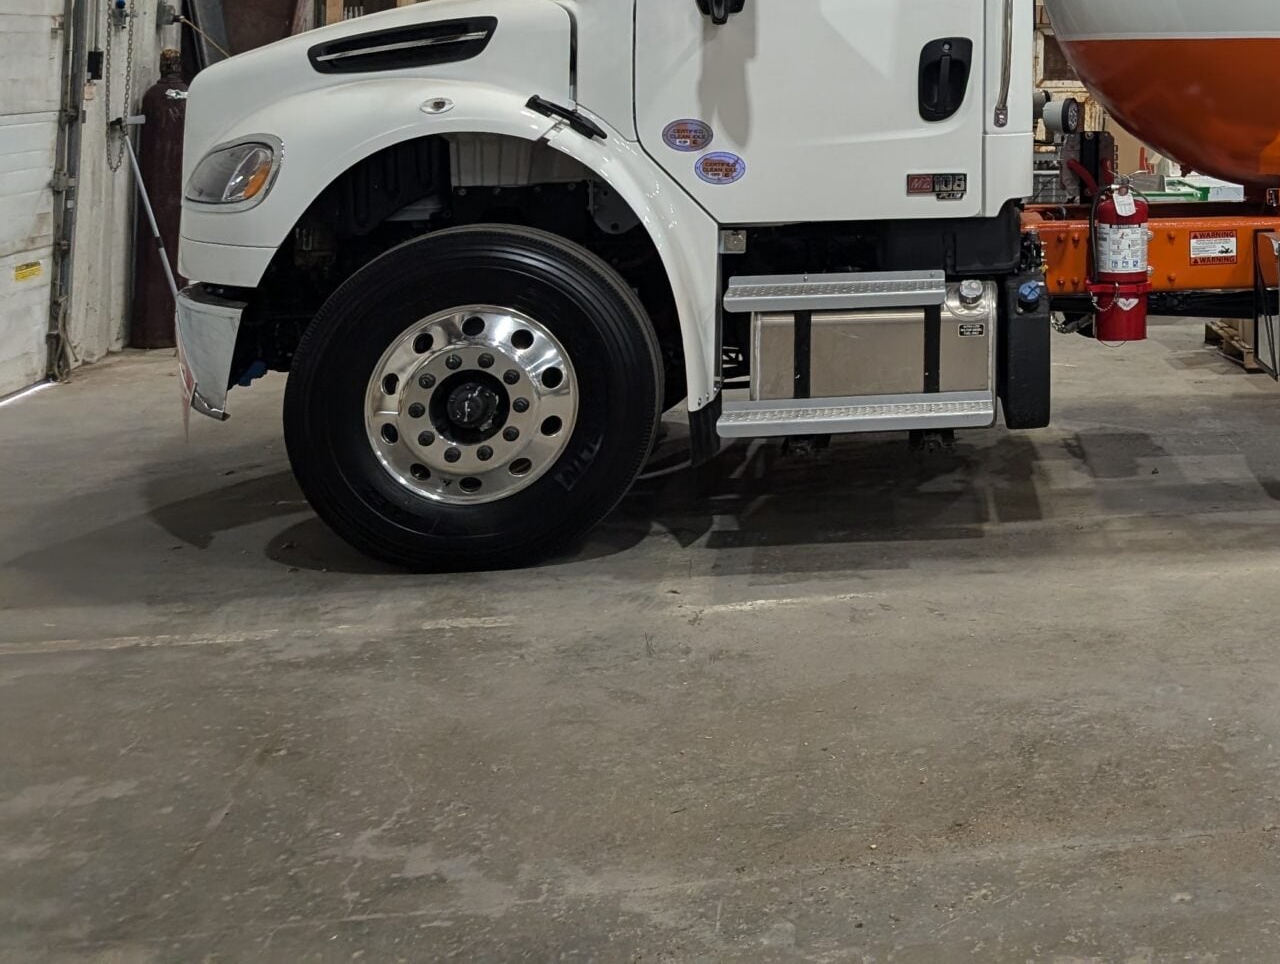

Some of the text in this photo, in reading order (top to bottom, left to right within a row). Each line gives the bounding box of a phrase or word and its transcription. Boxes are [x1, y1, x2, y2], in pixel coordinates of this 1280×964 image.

[911, 175, 965, 191] M2 106
[1200, 256, 1235, 264] WARNING
